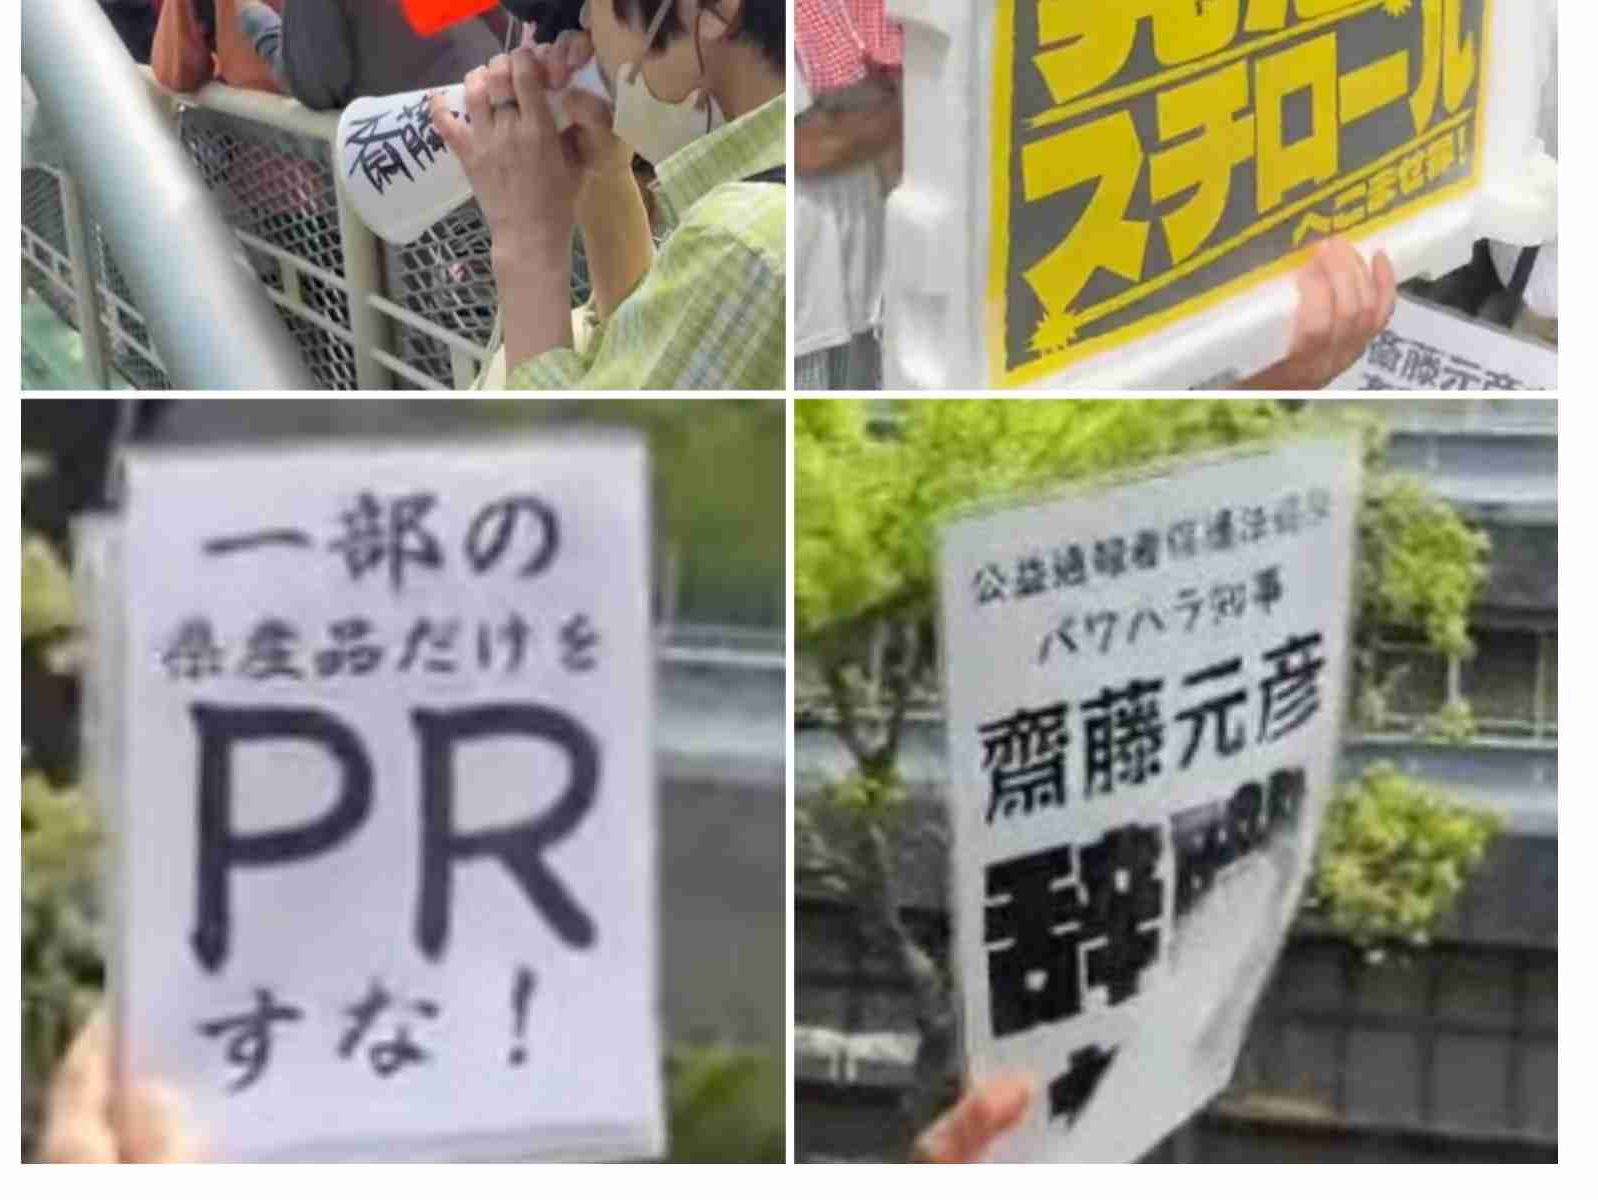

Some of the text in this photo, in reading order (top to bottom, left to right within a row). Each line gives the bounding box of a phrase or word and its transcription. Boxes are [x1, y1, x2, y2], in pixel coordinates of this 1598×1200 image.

[203, 490, 562, 593] 一部の
[162, 612, 602, 681] 県産品だけを
[977, 631, 1327, 827] 齋藤元彦
[187, 701, 603, 976] PR
[197, 965, 537, 1093] すな！
